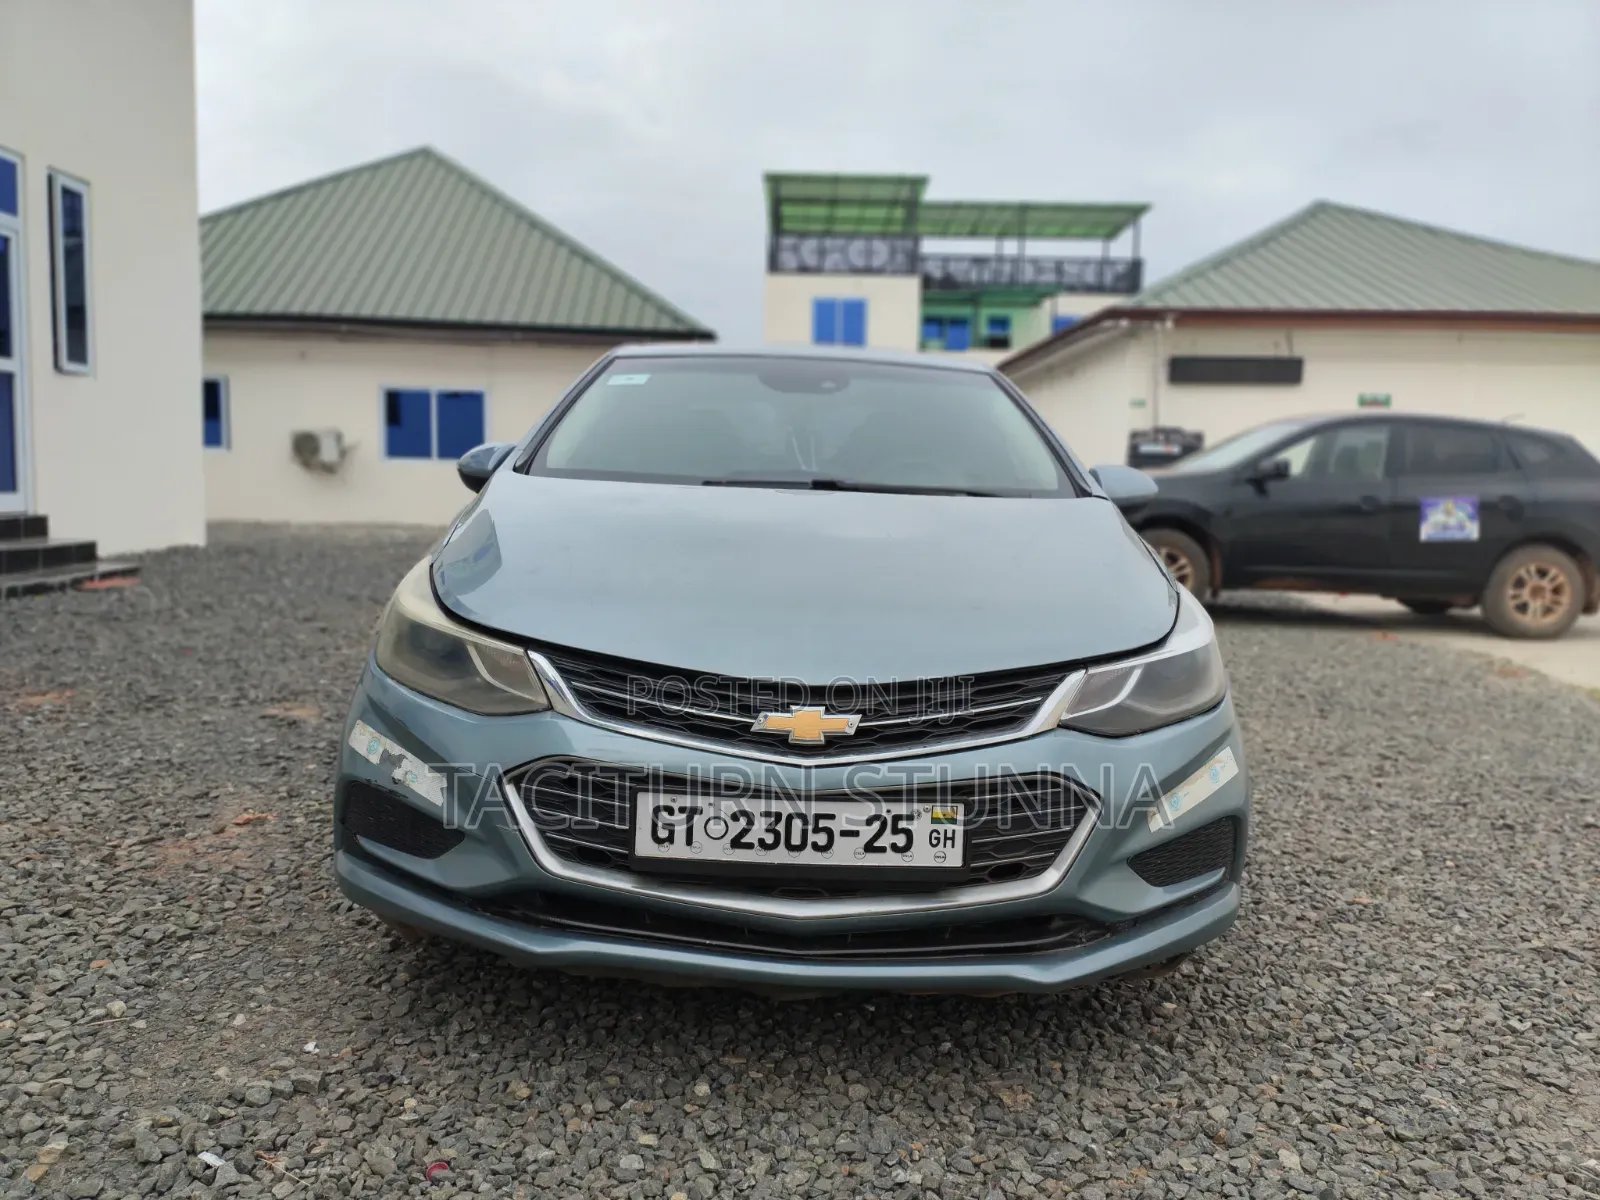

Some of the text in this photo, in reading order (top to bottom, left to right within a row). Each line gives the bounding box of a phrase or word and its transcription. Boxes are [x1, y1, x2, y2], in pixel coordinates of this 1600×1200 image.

[651, 804, 914, 854] GT 2305-25
[928, 828, 956, 849] GH
